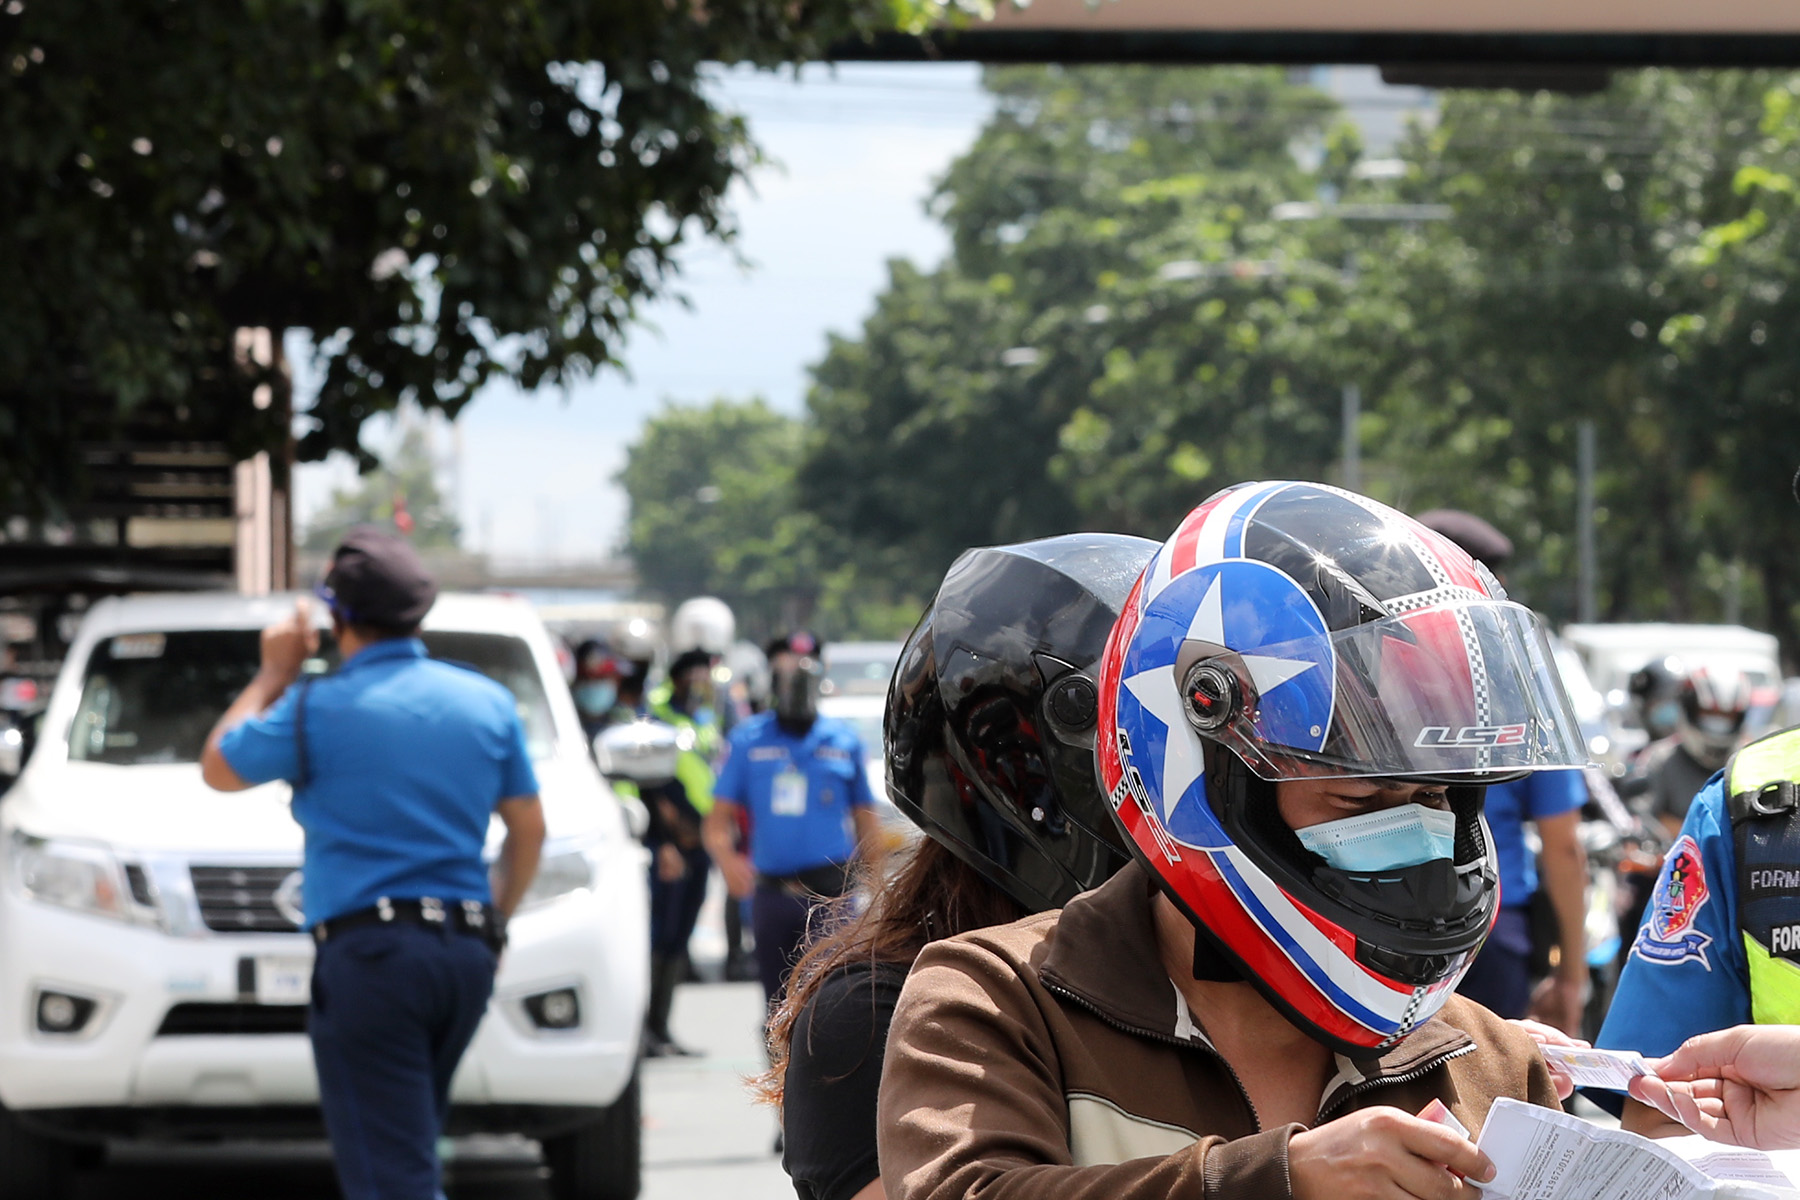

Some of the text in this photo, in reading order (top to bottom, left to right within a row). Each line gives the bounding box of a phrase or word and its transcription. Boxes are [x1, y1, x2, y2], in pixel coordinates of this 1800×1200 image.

[1413, 723, 1526, 748] LS2
[1118, 728, 1182, 867] LS2
[1545, 1146, 1576, 1191] 196730155
